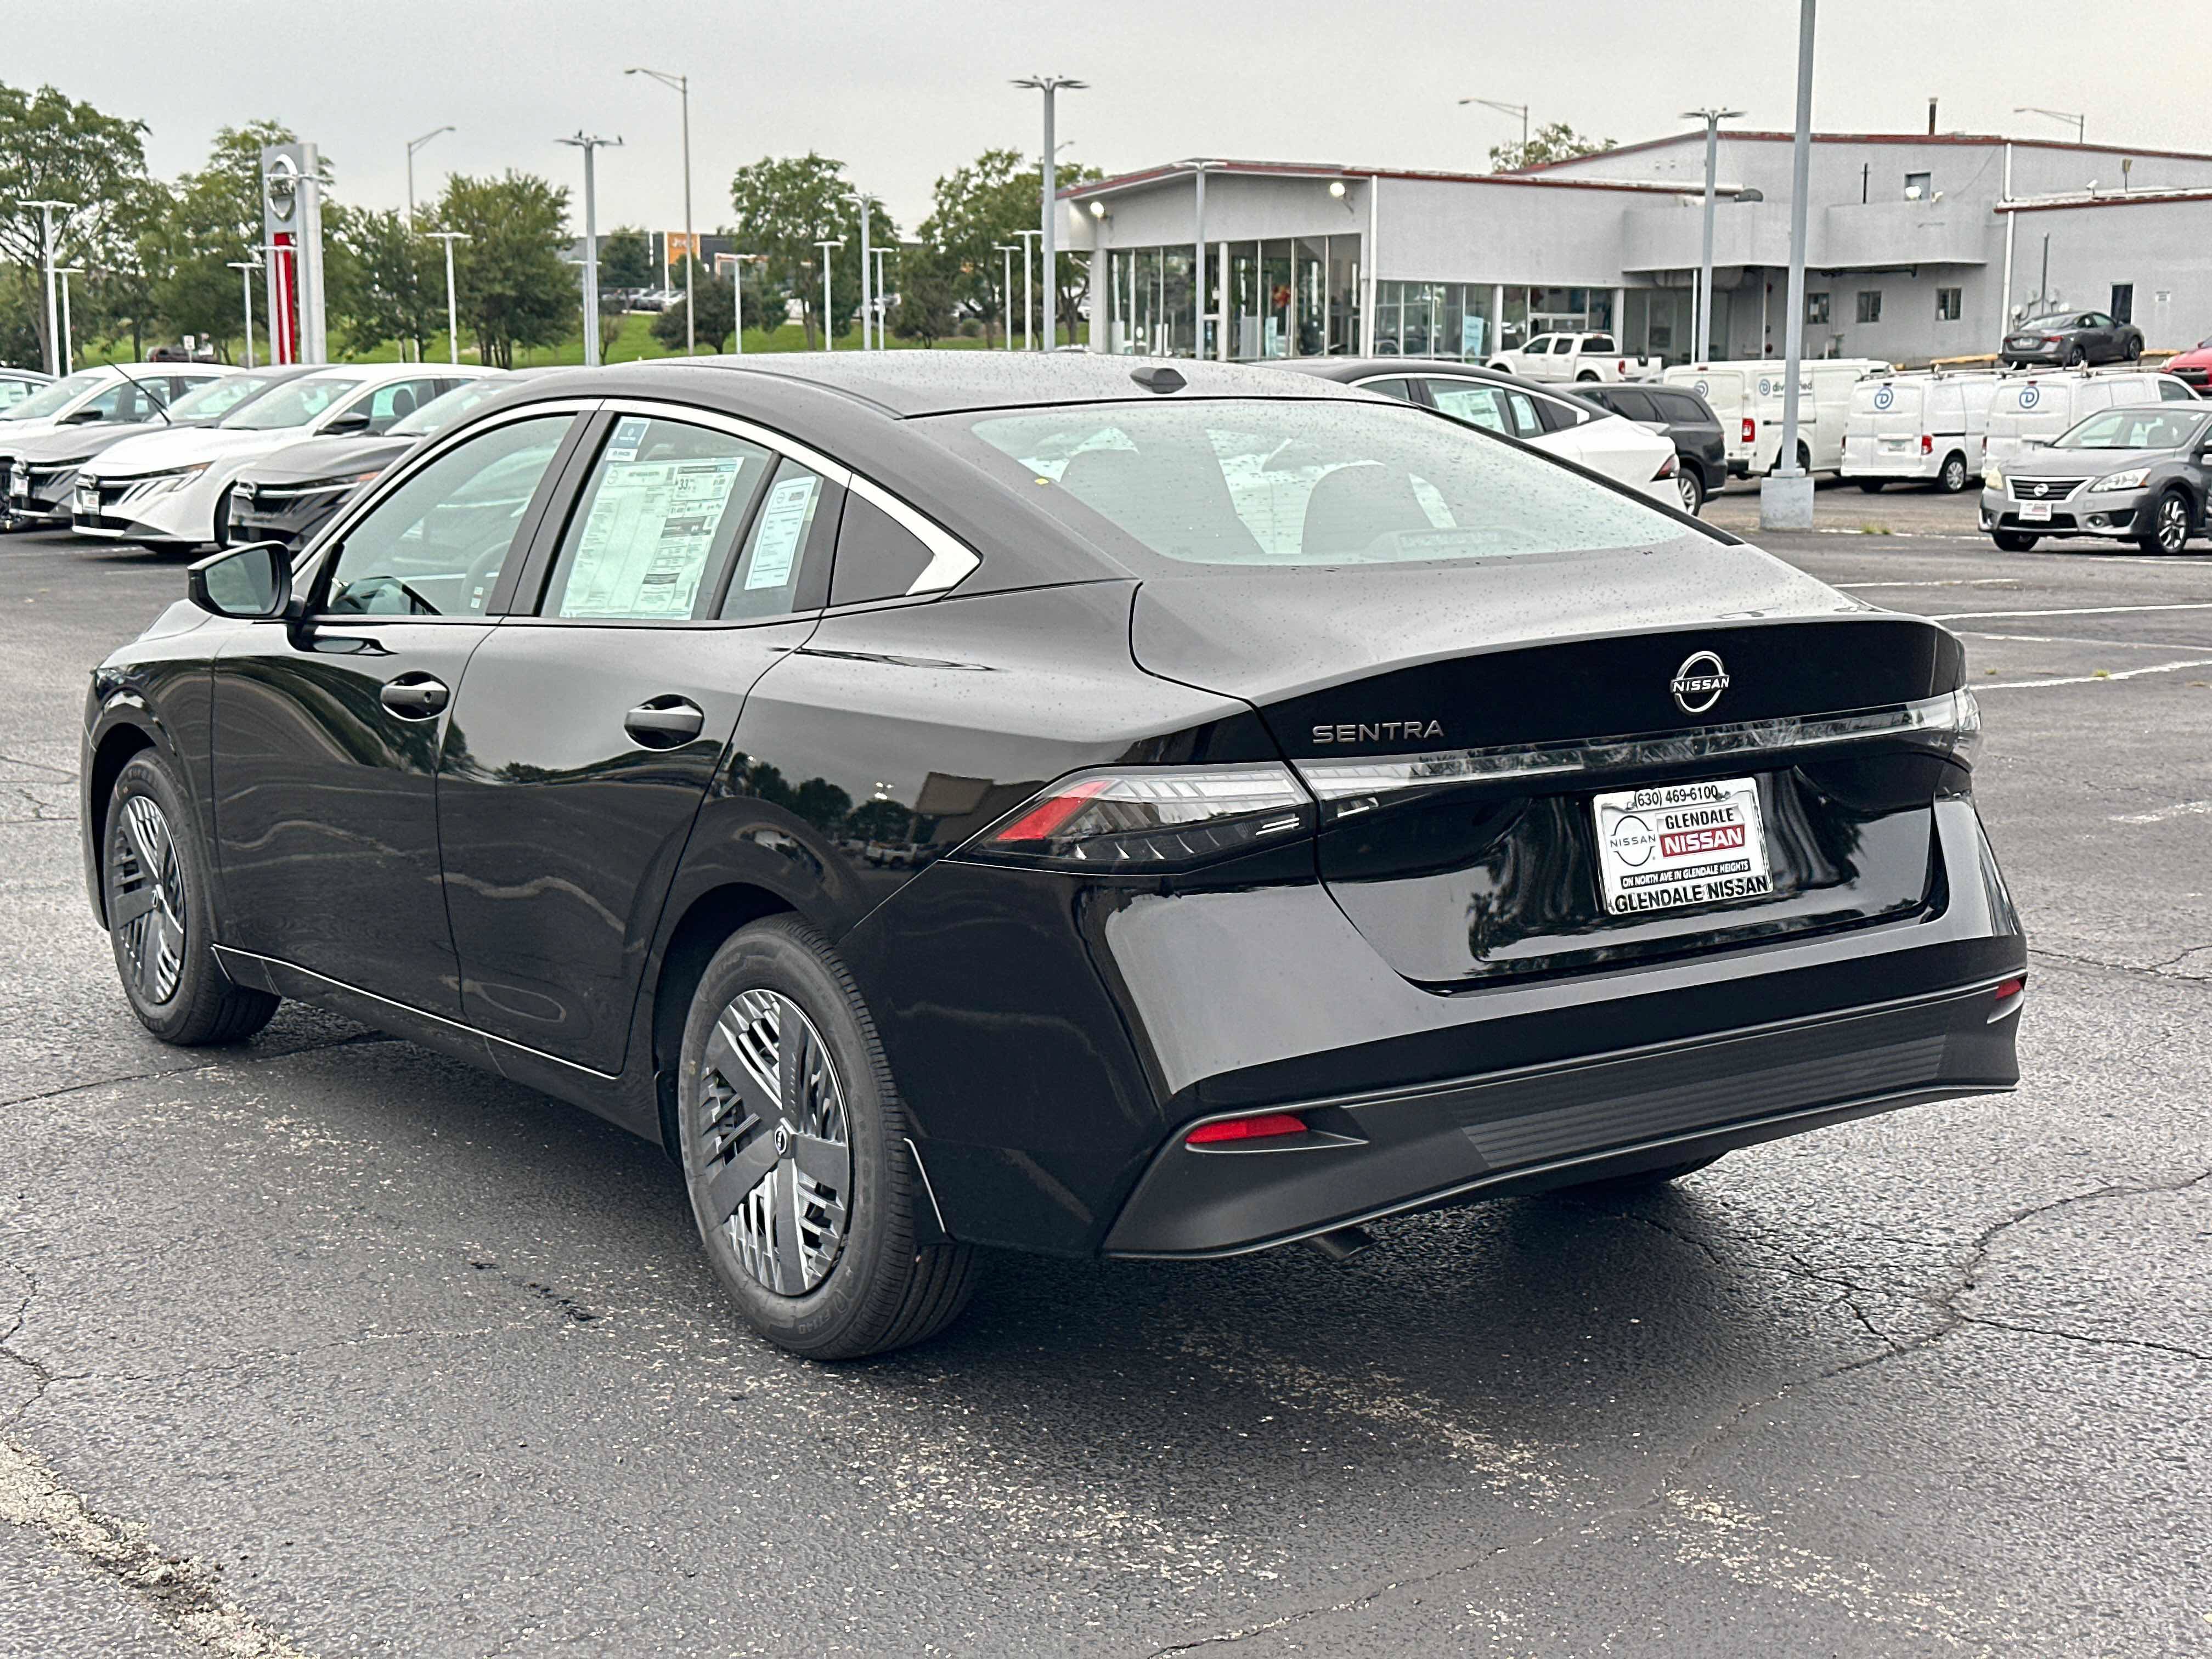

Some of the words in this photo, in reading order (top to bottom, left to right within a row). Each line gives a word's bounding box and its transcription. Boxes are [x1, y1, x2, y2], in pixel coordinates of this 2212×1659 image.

[1673, 677, 1730, 692] NISSAN
[1312, 720, 1444, 744] SENTRA
[1634, 789, 1662, 809] (630)
[1666, 785, 1718, 803] 469-6100
[1665, 808, 1735, 830] GLENDALE
[1610, 834, 1656, 848] NISSAN
[1664, 827, 1743, 854] NISSAN
[1622, 877, 1634, 887] ON
[1635, 873, 1658, 886] NORTH
[1660, 871, 1673, 882] AVE
[1674, 870, 1682, 880] IN
[1683, 865, 1718, 879] GLENDALE
[1719, 860, 1748, 873] HEIGHTS
[1615, 884, 1704, 913] GLENDALE
[1707, 877, 1768, 900] NISSAN
